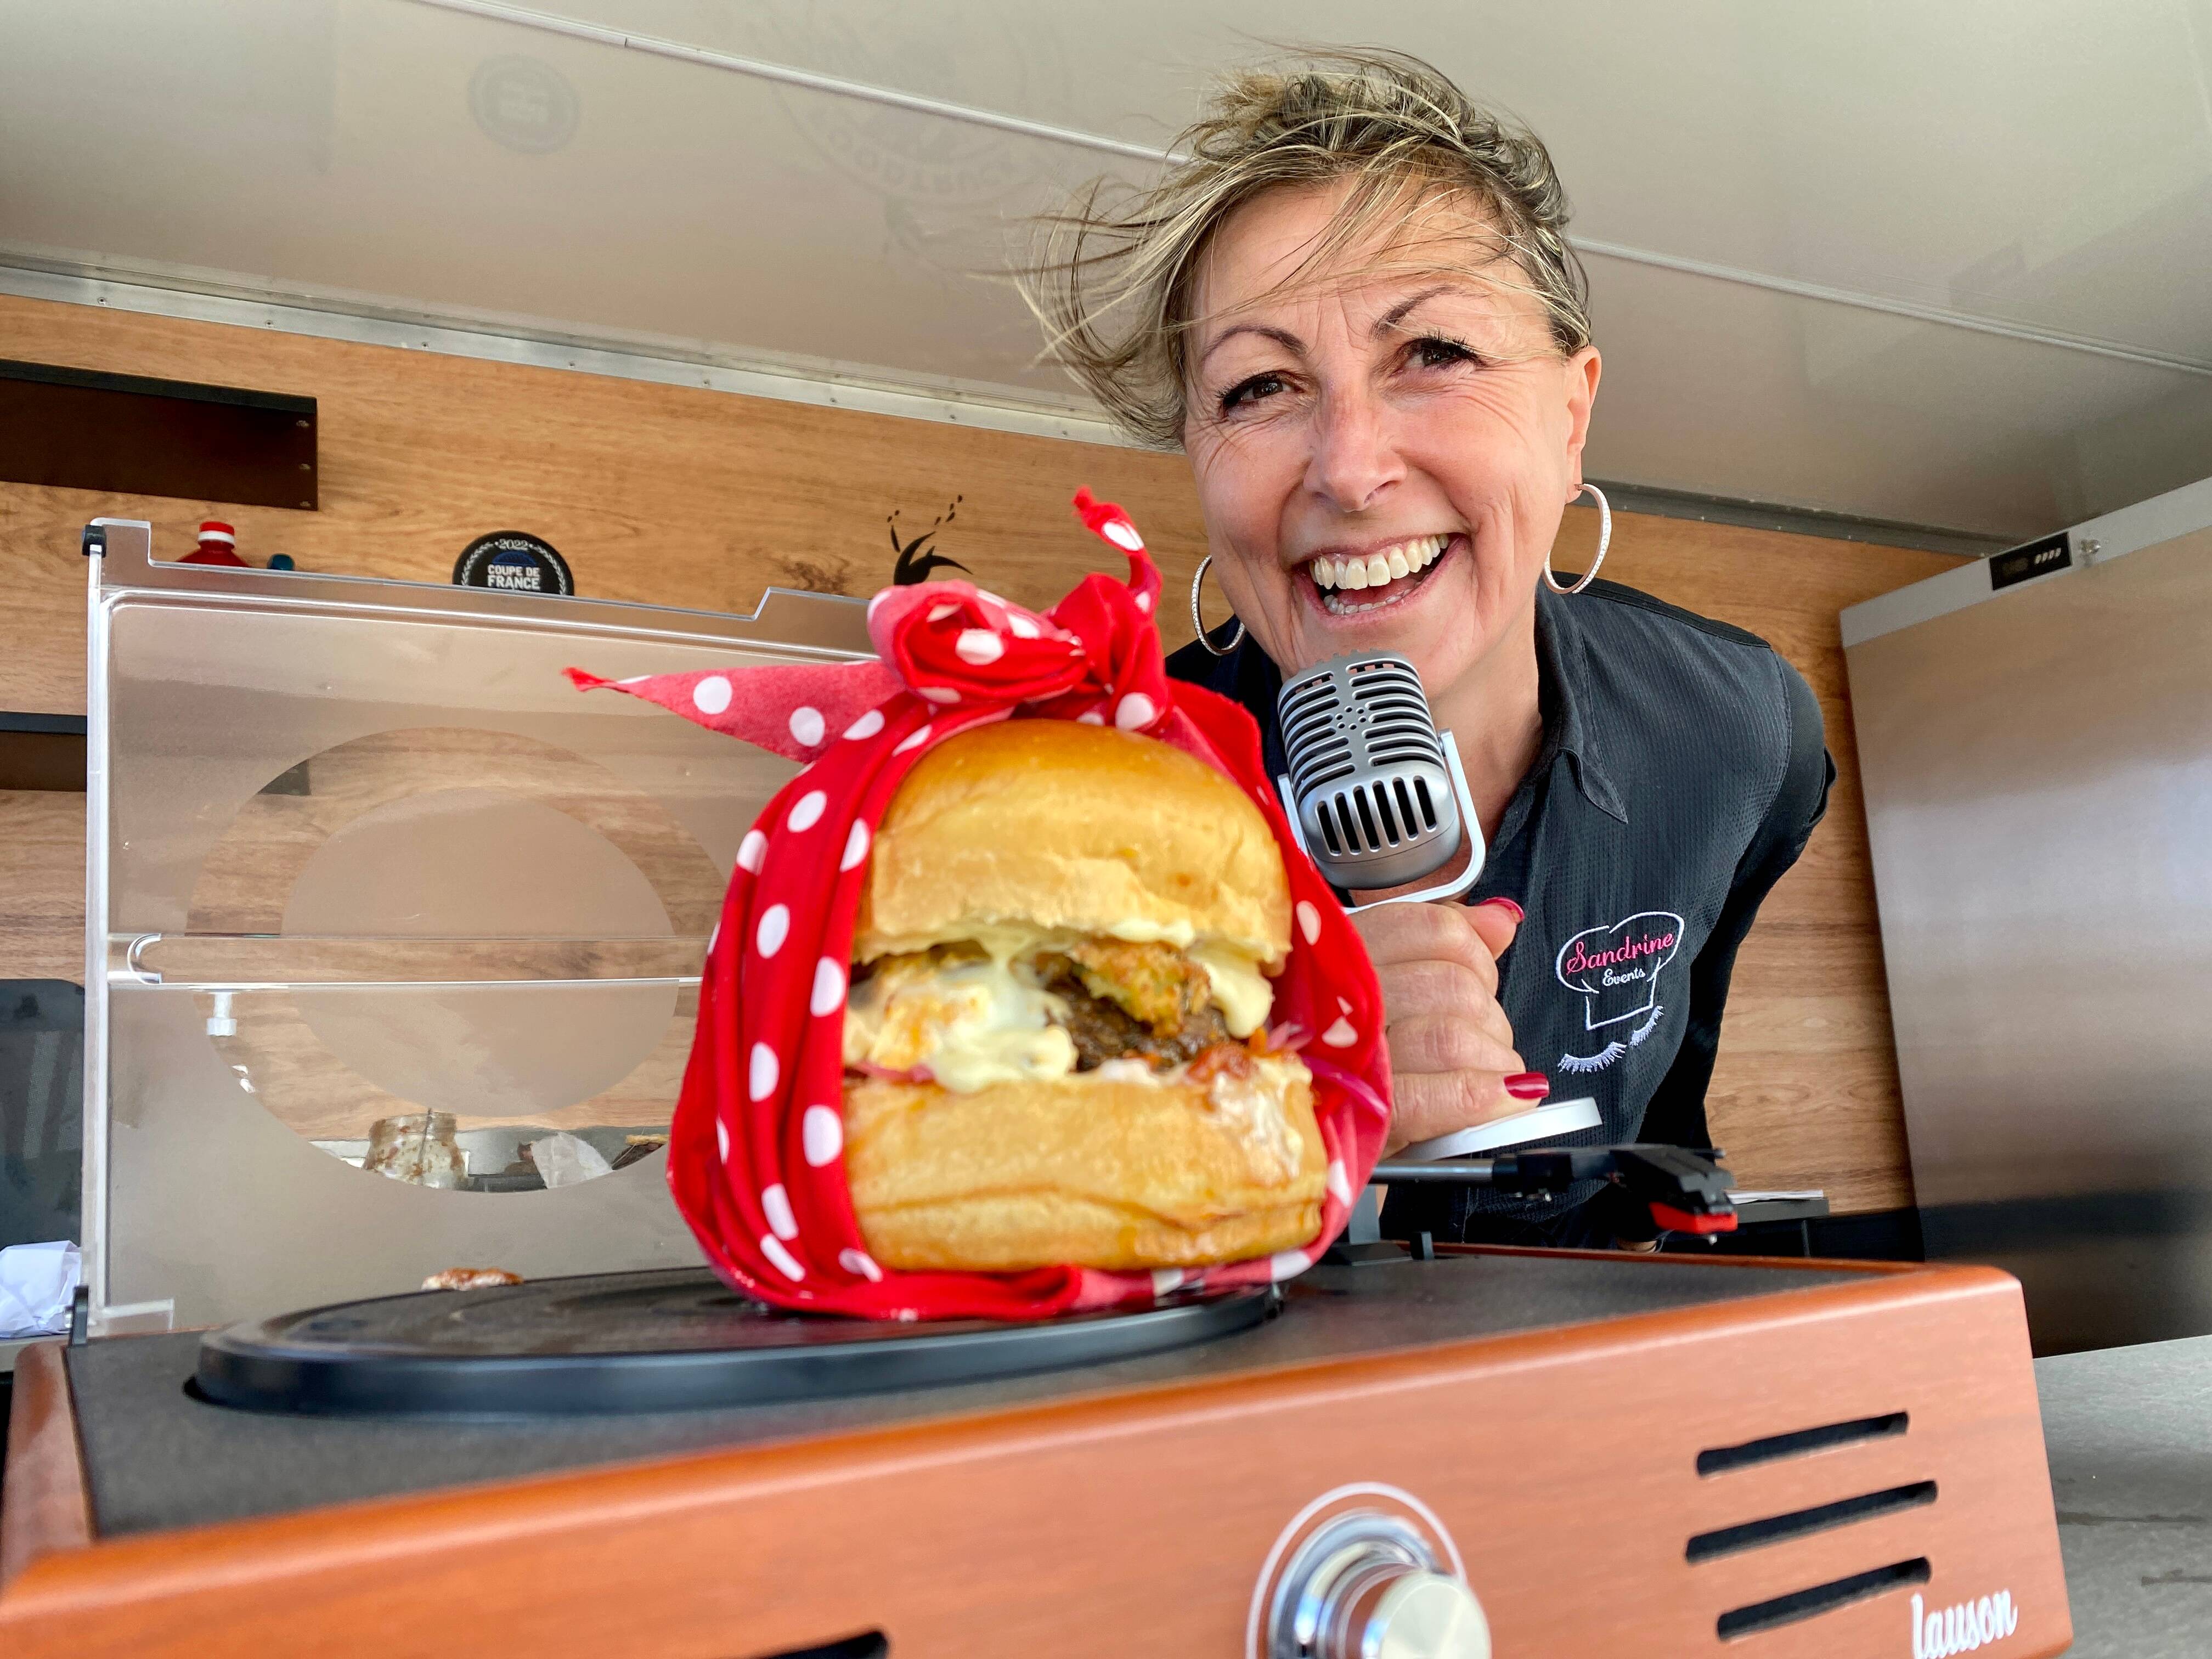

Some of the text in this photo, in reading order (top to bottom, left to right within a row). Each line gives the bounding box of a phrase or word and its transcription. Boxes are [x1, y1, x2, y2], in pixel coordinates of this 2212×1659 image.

[499, 539, 528, 550] 2022
[487, 564, 540, 577] COUPE DE
[487, 575, 540, 590] FRANCE
[1566, 933, 1674, 975] Sandrine
[1602, 967, 1646, 986] Events
